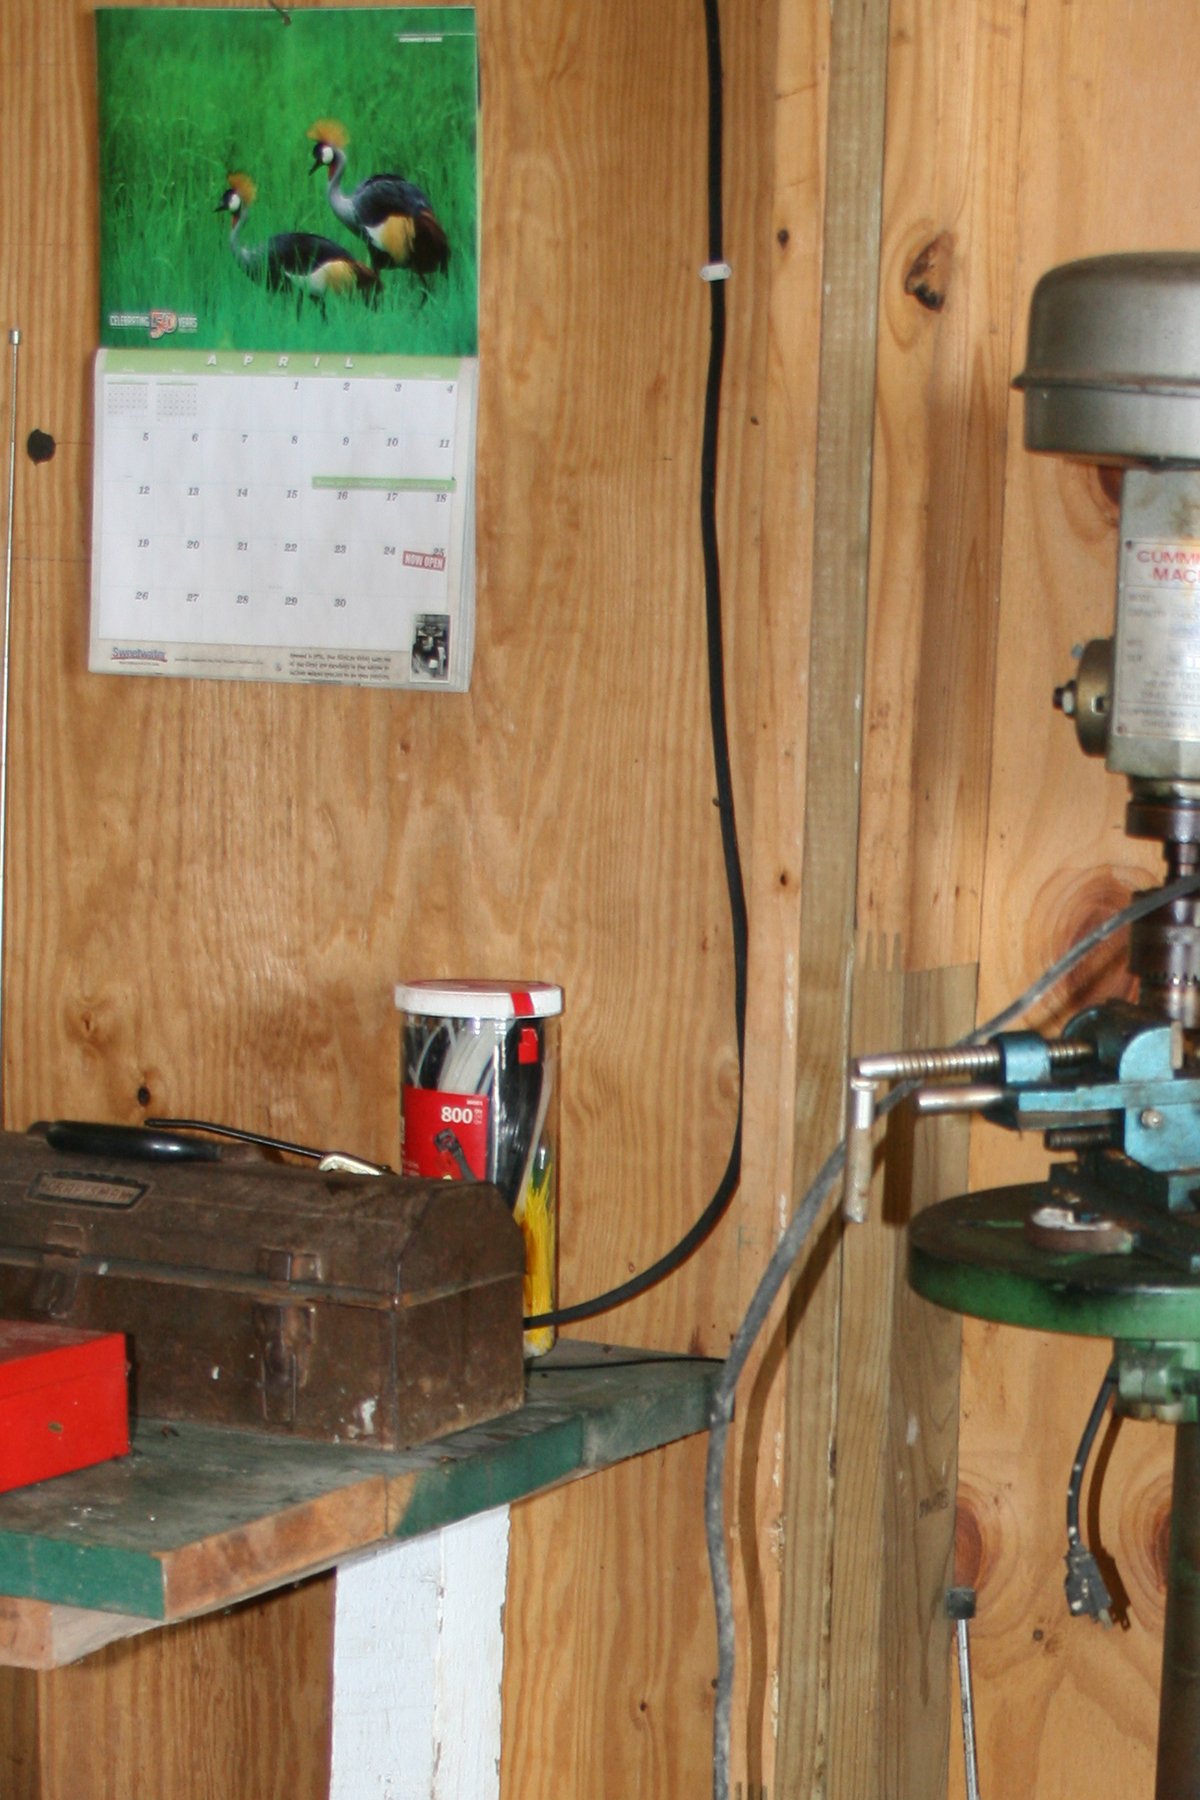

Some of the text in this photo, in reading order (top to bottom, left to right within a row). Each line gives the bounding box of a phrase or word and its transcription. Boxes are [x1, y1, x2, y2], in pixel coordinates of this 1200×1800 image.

[206, 354, 354, 369] APRIL
[343, 382, 351, 391] 2
[394, 383, 402, 392] 3
[447, 385, 454, 394] 4
[143, 432, 450, 448] 5 6 7 8 9 10 11
[138, 486, 447, 503] 12 13 14 15 16 17 18
[137, 539, 149, 548] 19
[186, 540, 200, 549] 20
[237, 541, 248, 551] 21
[284, 543, 297, 552] 22
[334, 545, 347, 554] 23
[384, 546, 396, 556] 24
[403, 553, 444, 569] NOW OPEN
[135, 591, 347, 608] 26 27 28 29 30
[112, 647, 166, 660] Sweetwater
[441, 1106, 473, 1124] 800
